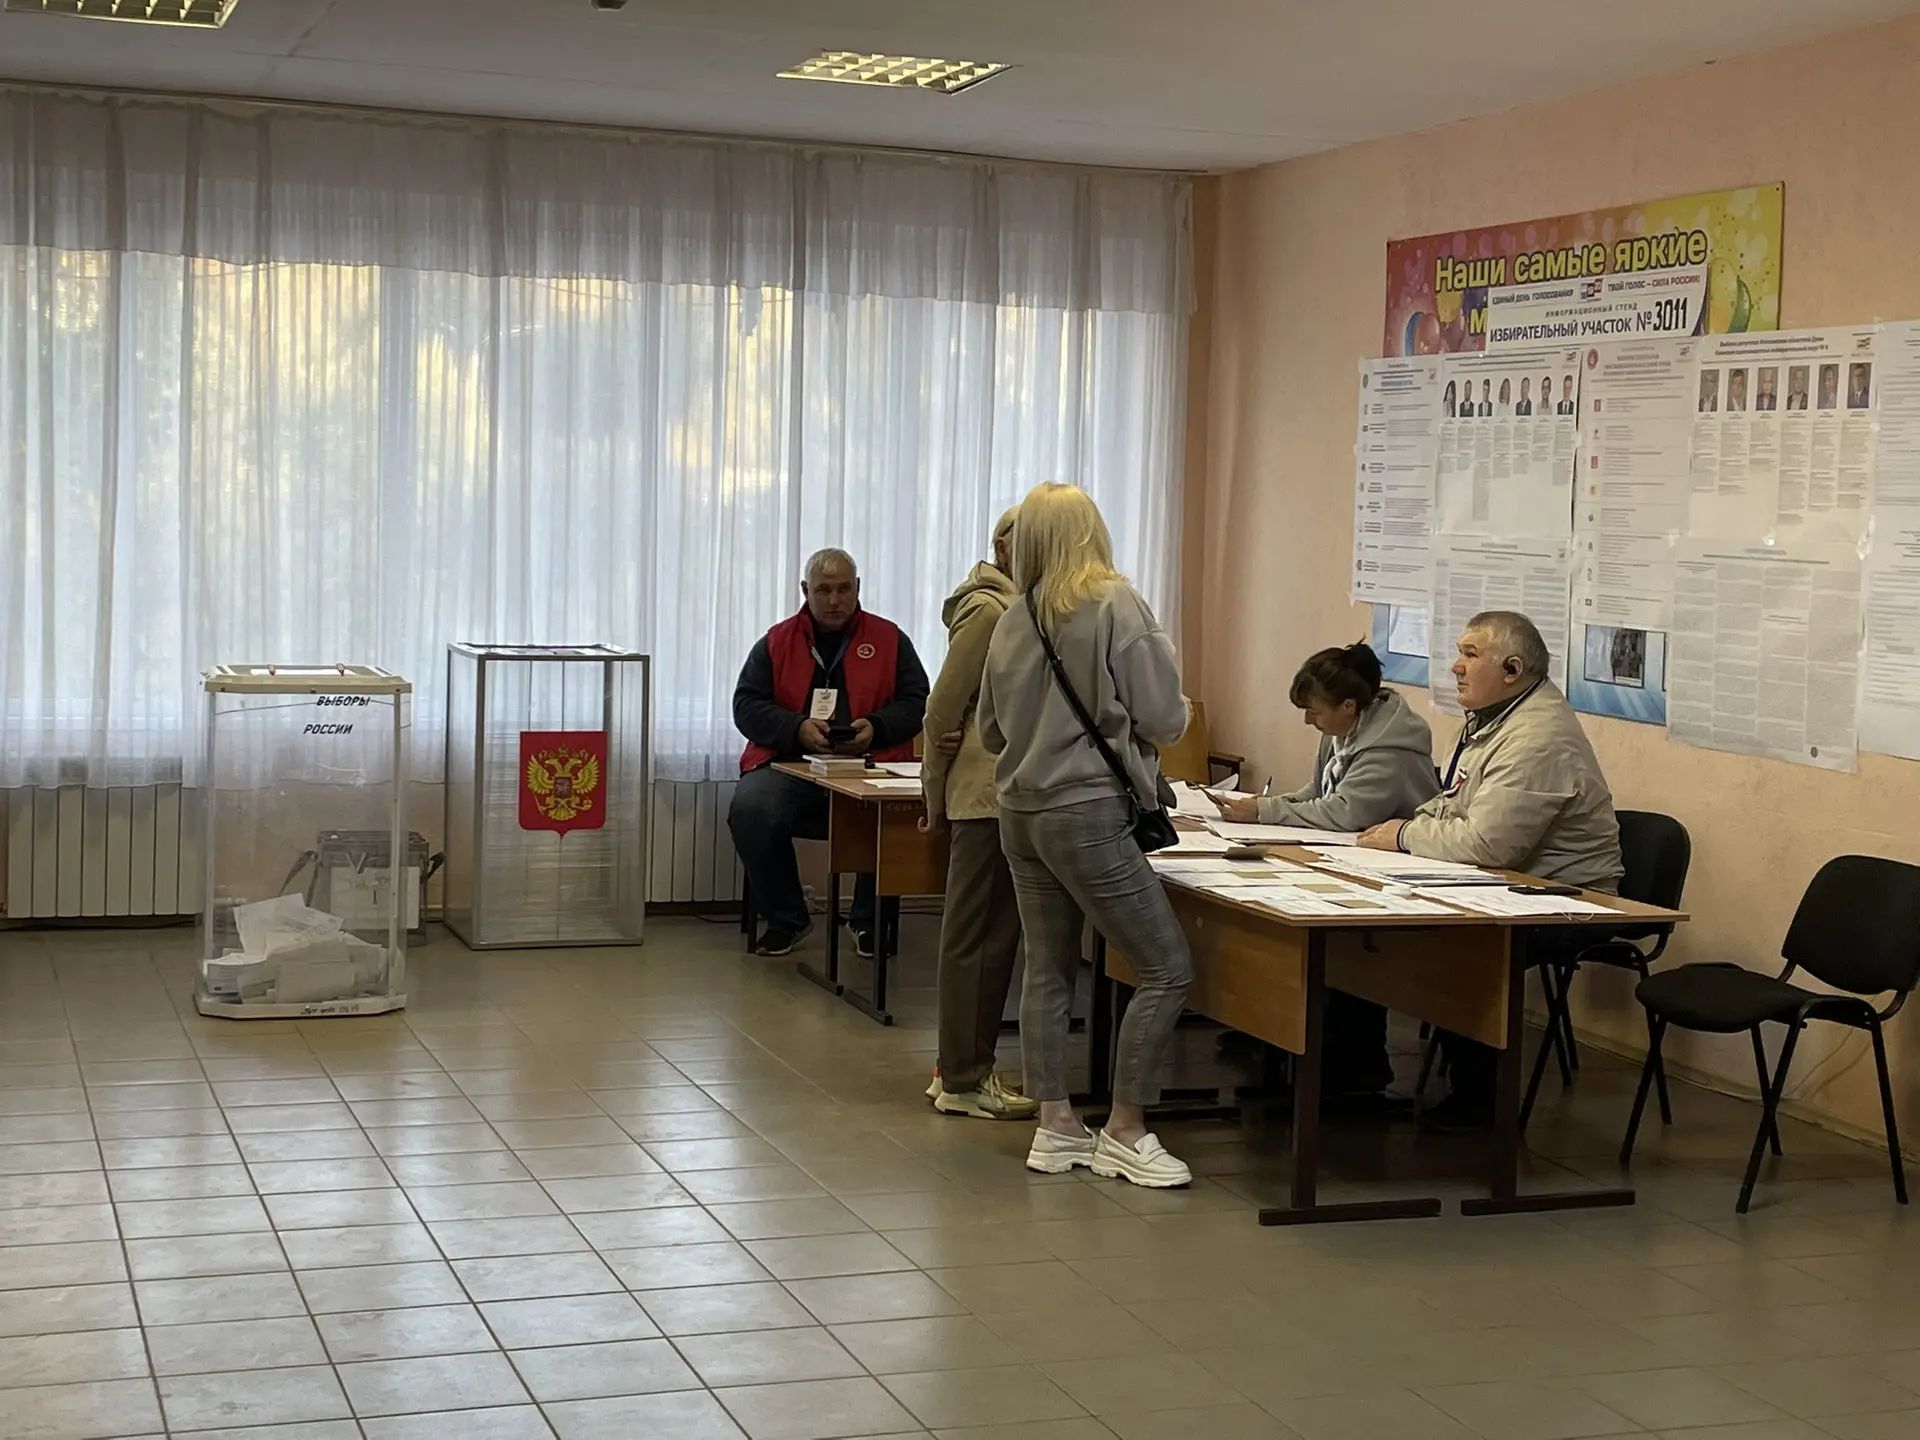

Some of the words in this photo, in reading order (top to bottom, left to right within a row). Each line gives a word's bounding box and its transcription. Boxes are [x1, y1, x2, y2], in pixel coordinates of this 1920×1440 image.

[1435, 255, 1506, 292] Наши
[1514, 243, 1606, 283] самые
[1614, 229, 1707, 272] яркие
[1608, 280, 1624, 291] ТВОЙ
[1625, 279, 1646, 289] ГОЛОС
[1652, 277, 1669, 287] СИЛА
[1515, 292, 1530, 303] ДЕНЬ
[1532, 289, 1574, 300] ГОЛОСОВАНИЯ
[1545, 304, 1612, 317] ИНФОРМАЦИОННЫЙ
[1615, 302, 1638, 312] СТЕНД
[1490, 319, 1578, 343] ИЗБИРАТЕЛЬНЫЙ
[1581, 317, 1632, 337] УЧАСТОК
[1636, 310, 1652, 332] №
[1653, 297, 1688, 332] 3011
[316, 695, 371, 707] ВЫБОРЫ
[303, 723, 354, 735] РОССИИ
